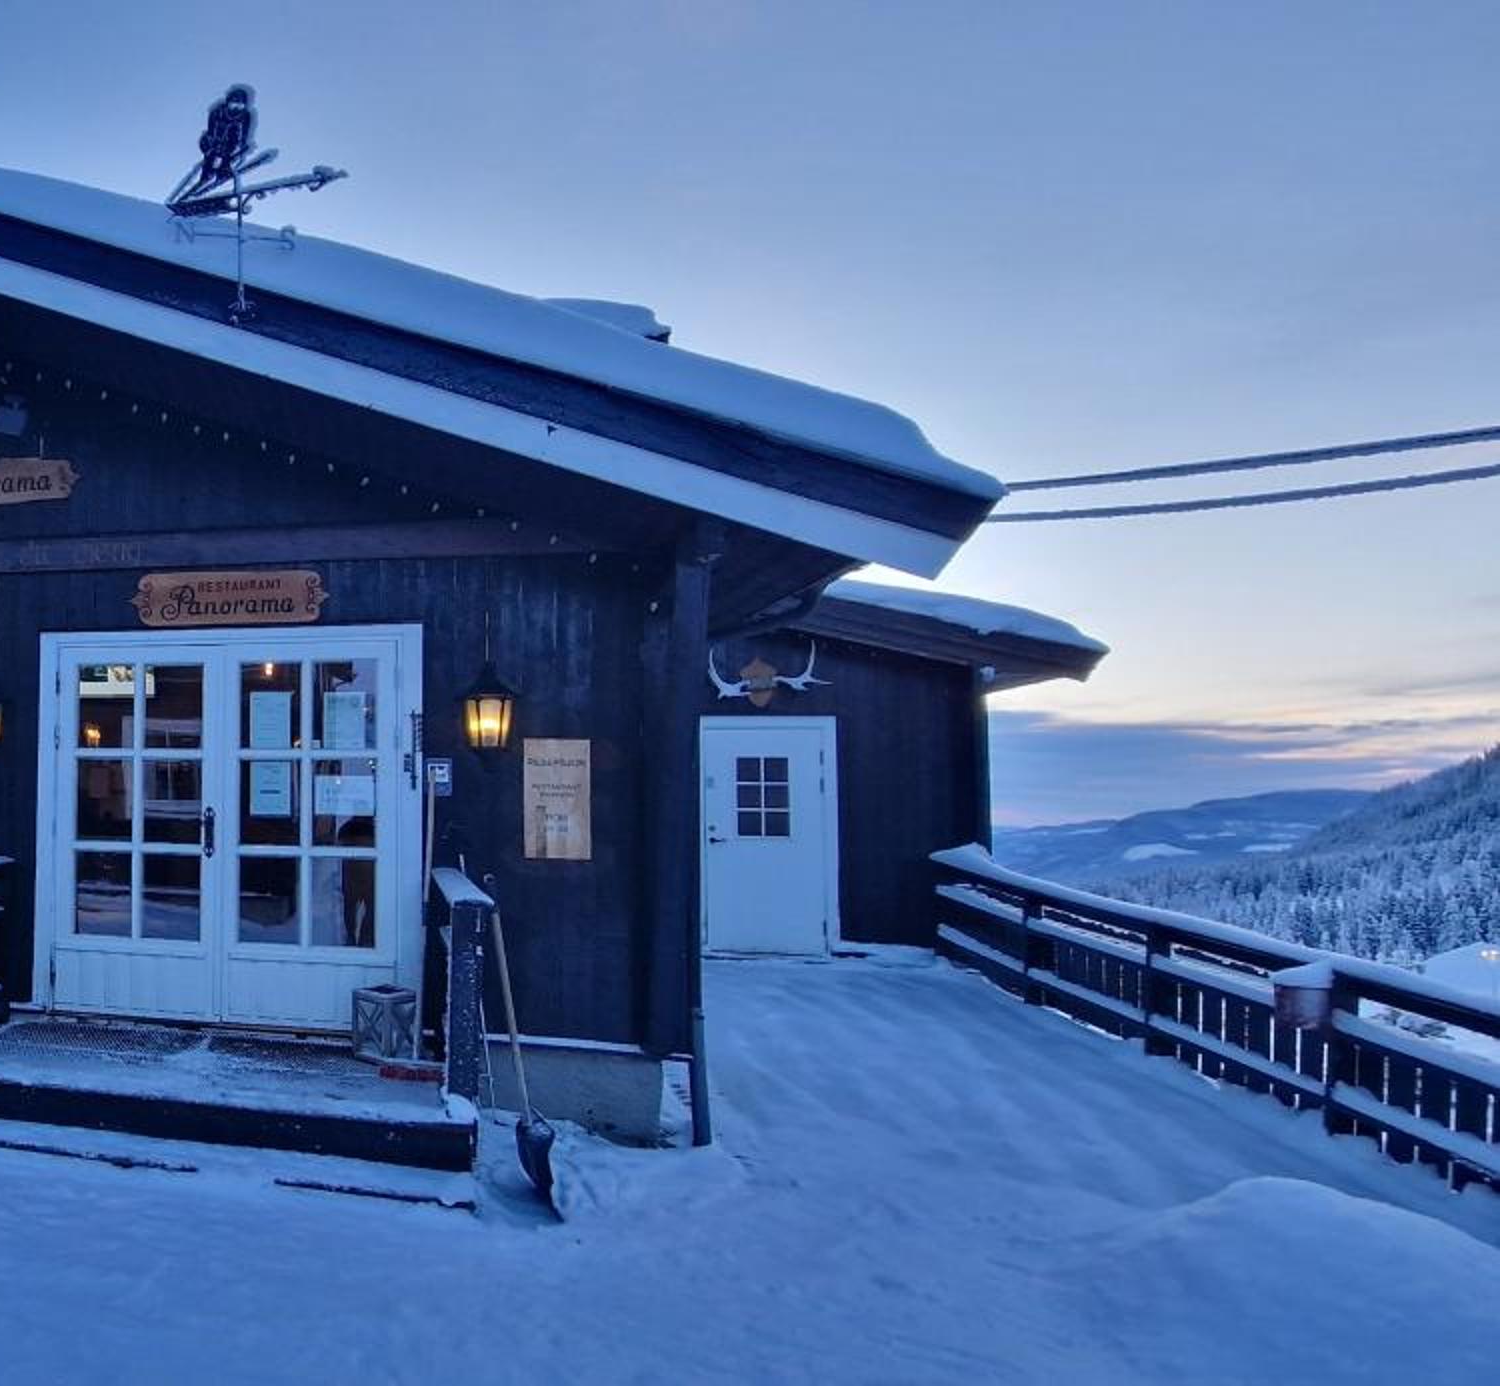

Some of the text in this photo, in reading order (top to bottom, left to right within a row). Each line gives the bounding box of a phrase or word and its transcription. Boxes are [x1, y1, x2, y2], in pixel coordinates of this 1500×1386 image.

[172, 219, 196, 244] N
[197, 579, 281, 593] RESTAURANT
[161, 584, 295, 621] Panorama
